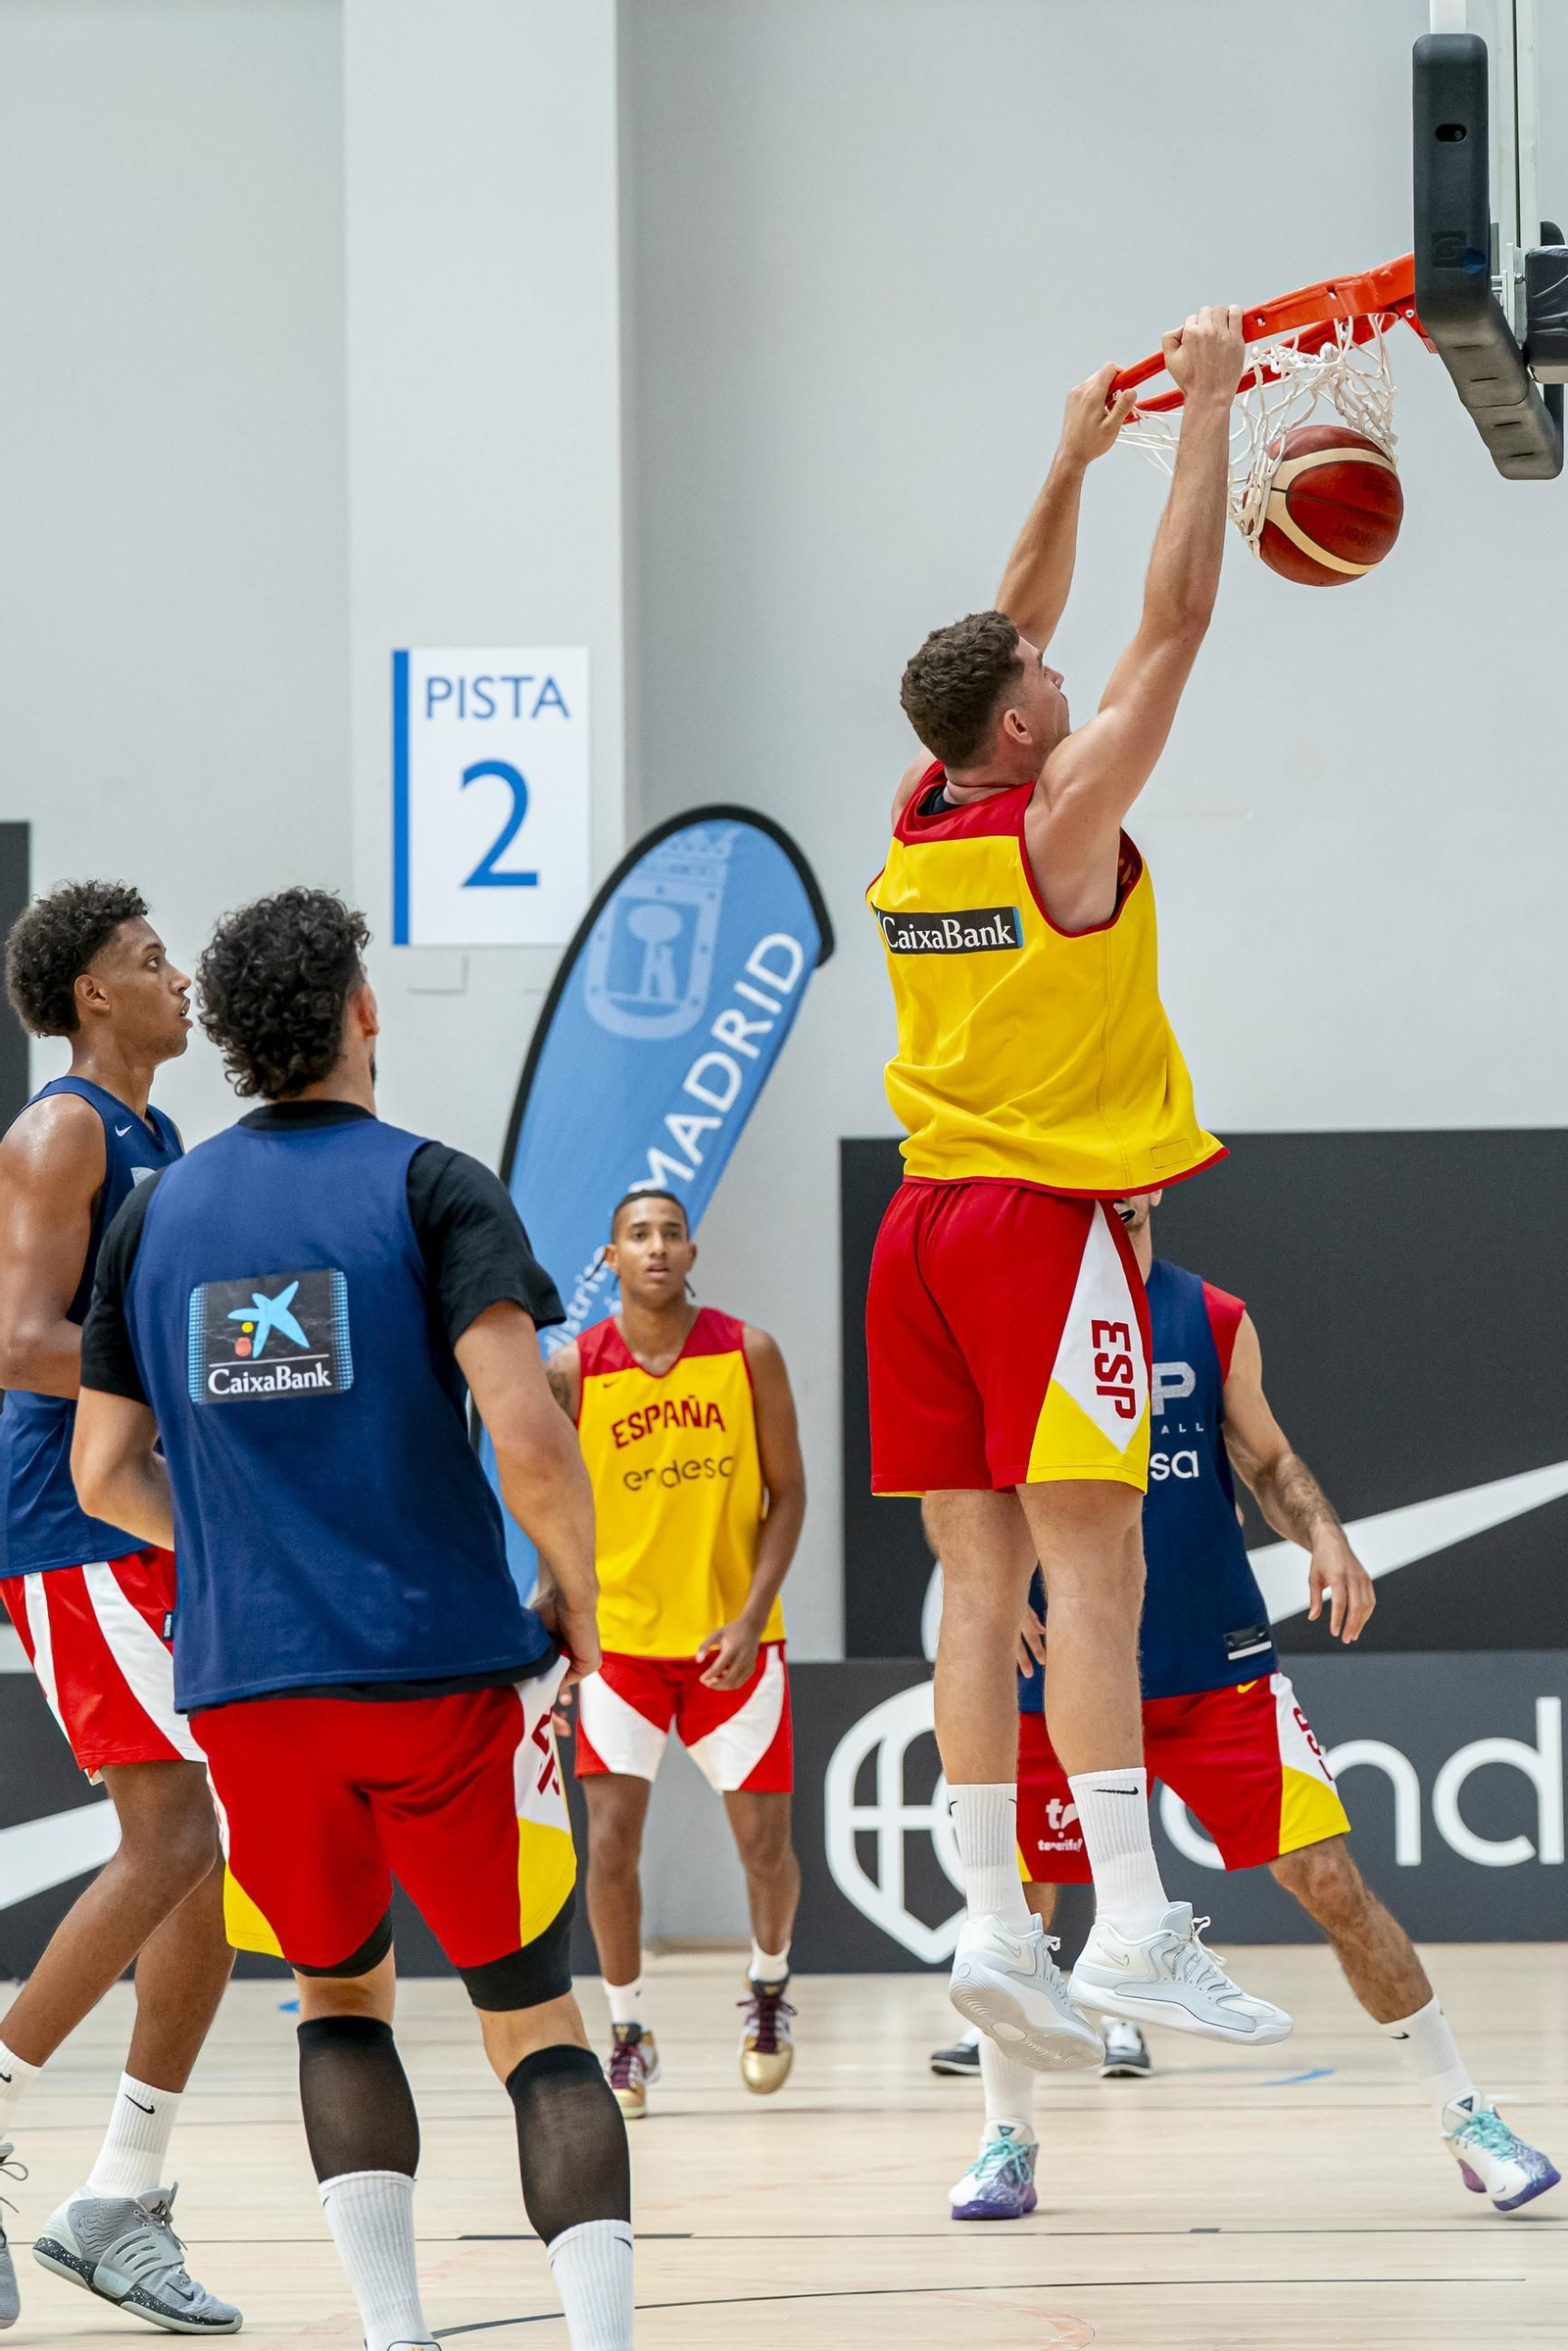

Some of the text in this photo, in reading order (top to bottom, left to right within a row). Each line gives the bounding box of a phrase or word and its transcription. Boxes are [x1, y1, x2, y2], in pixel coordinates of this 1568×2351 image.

[425, 675, 570, 719] PISTA
[461, 759, 538, 888] 2
[882, 913, 1015, 950] CaixaBank
[627, 932, 804, 1193] MADRID
[208, 1361, 332, 1396] CaixaBank
[1091, 1319, 1137, 1420] ESP
[612, 1395, 726, 1448] ESPAÑA
